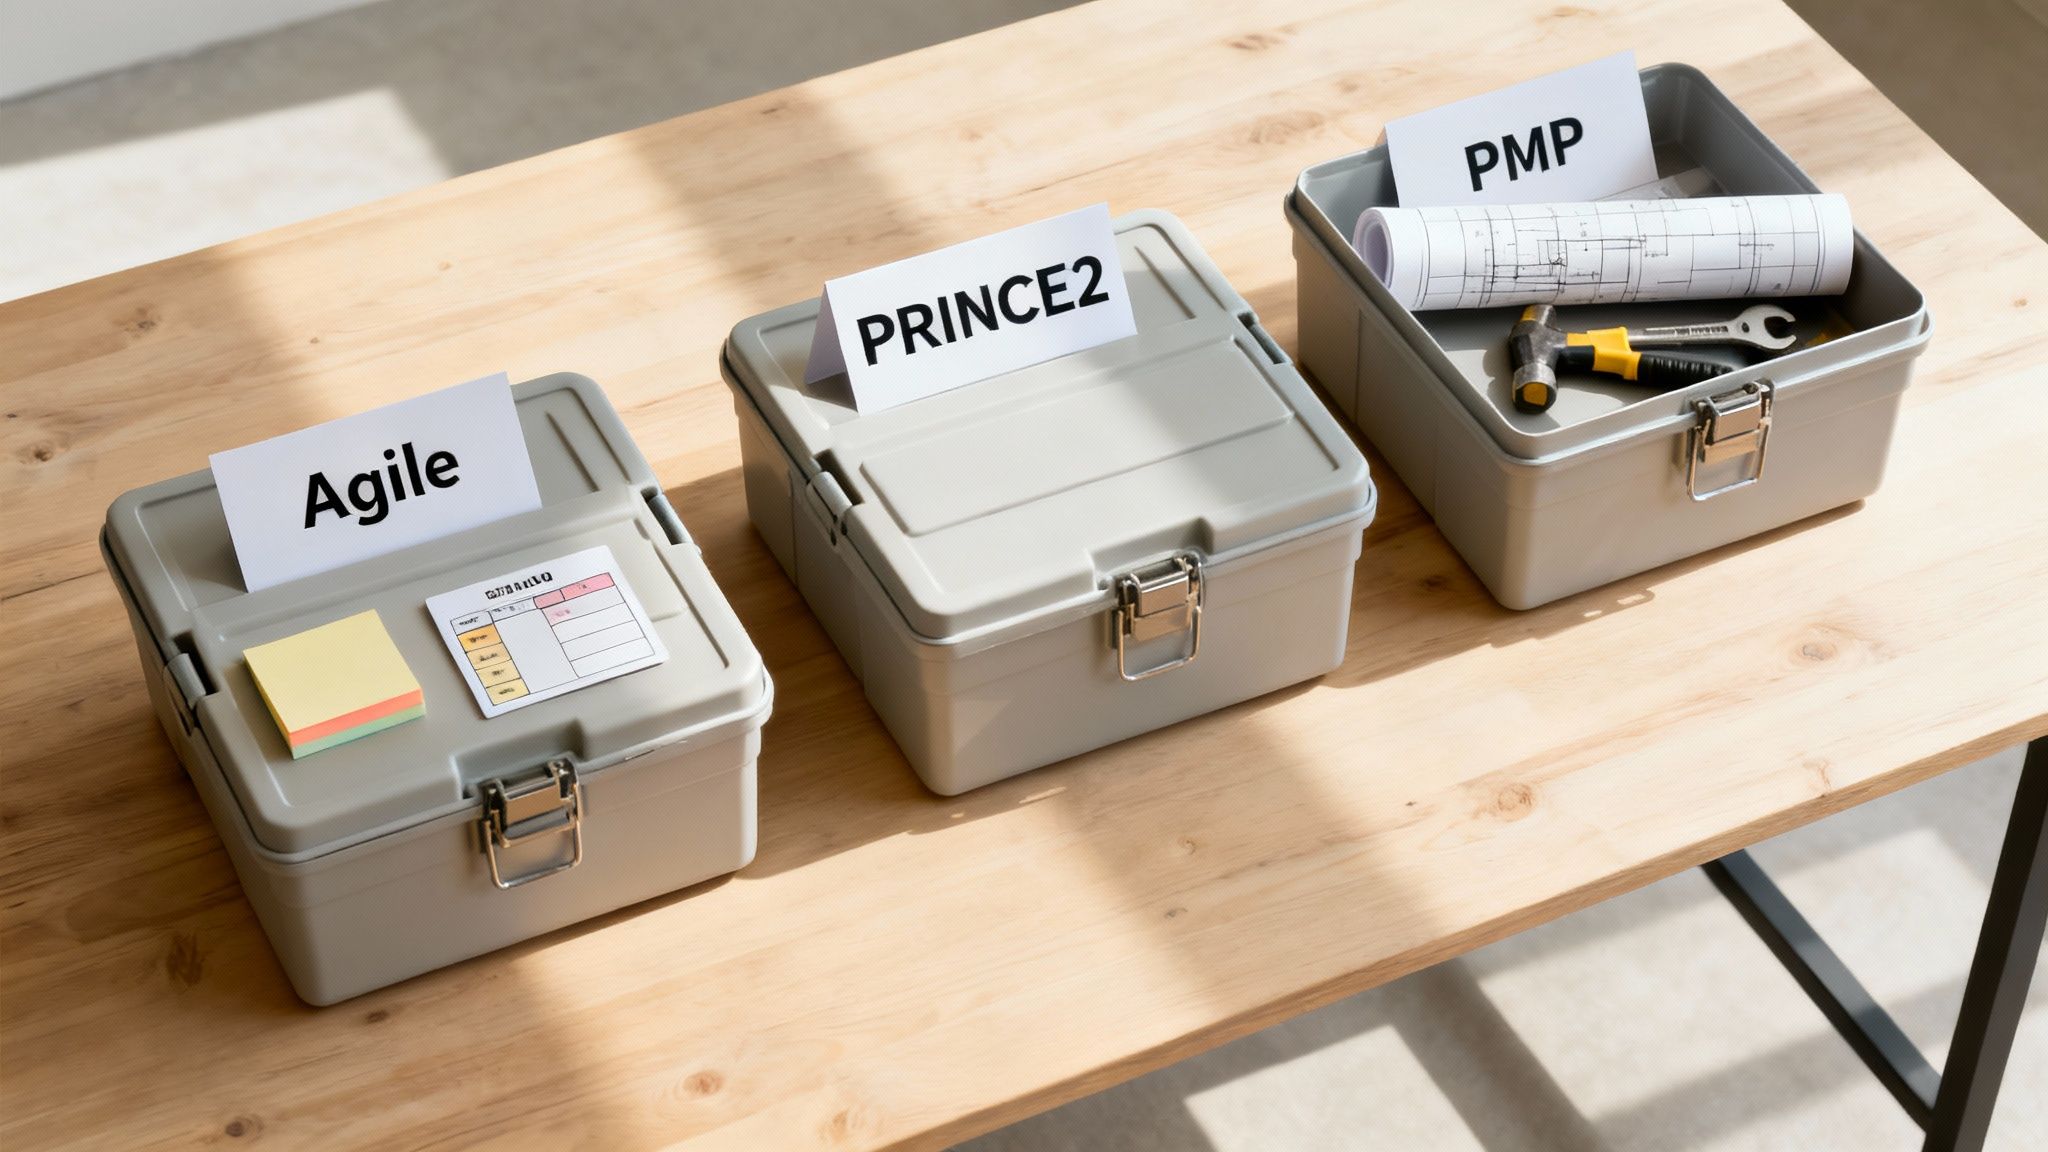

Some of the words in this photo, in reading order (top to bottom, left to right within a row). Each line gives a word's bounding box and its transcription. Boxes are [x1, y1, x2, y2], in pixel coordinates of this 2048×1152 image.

[1464, 116, 1584, 192] PMP
[856, 255, 1110, 367] PRINCE2
[303, 441, 460, 530] Agile
